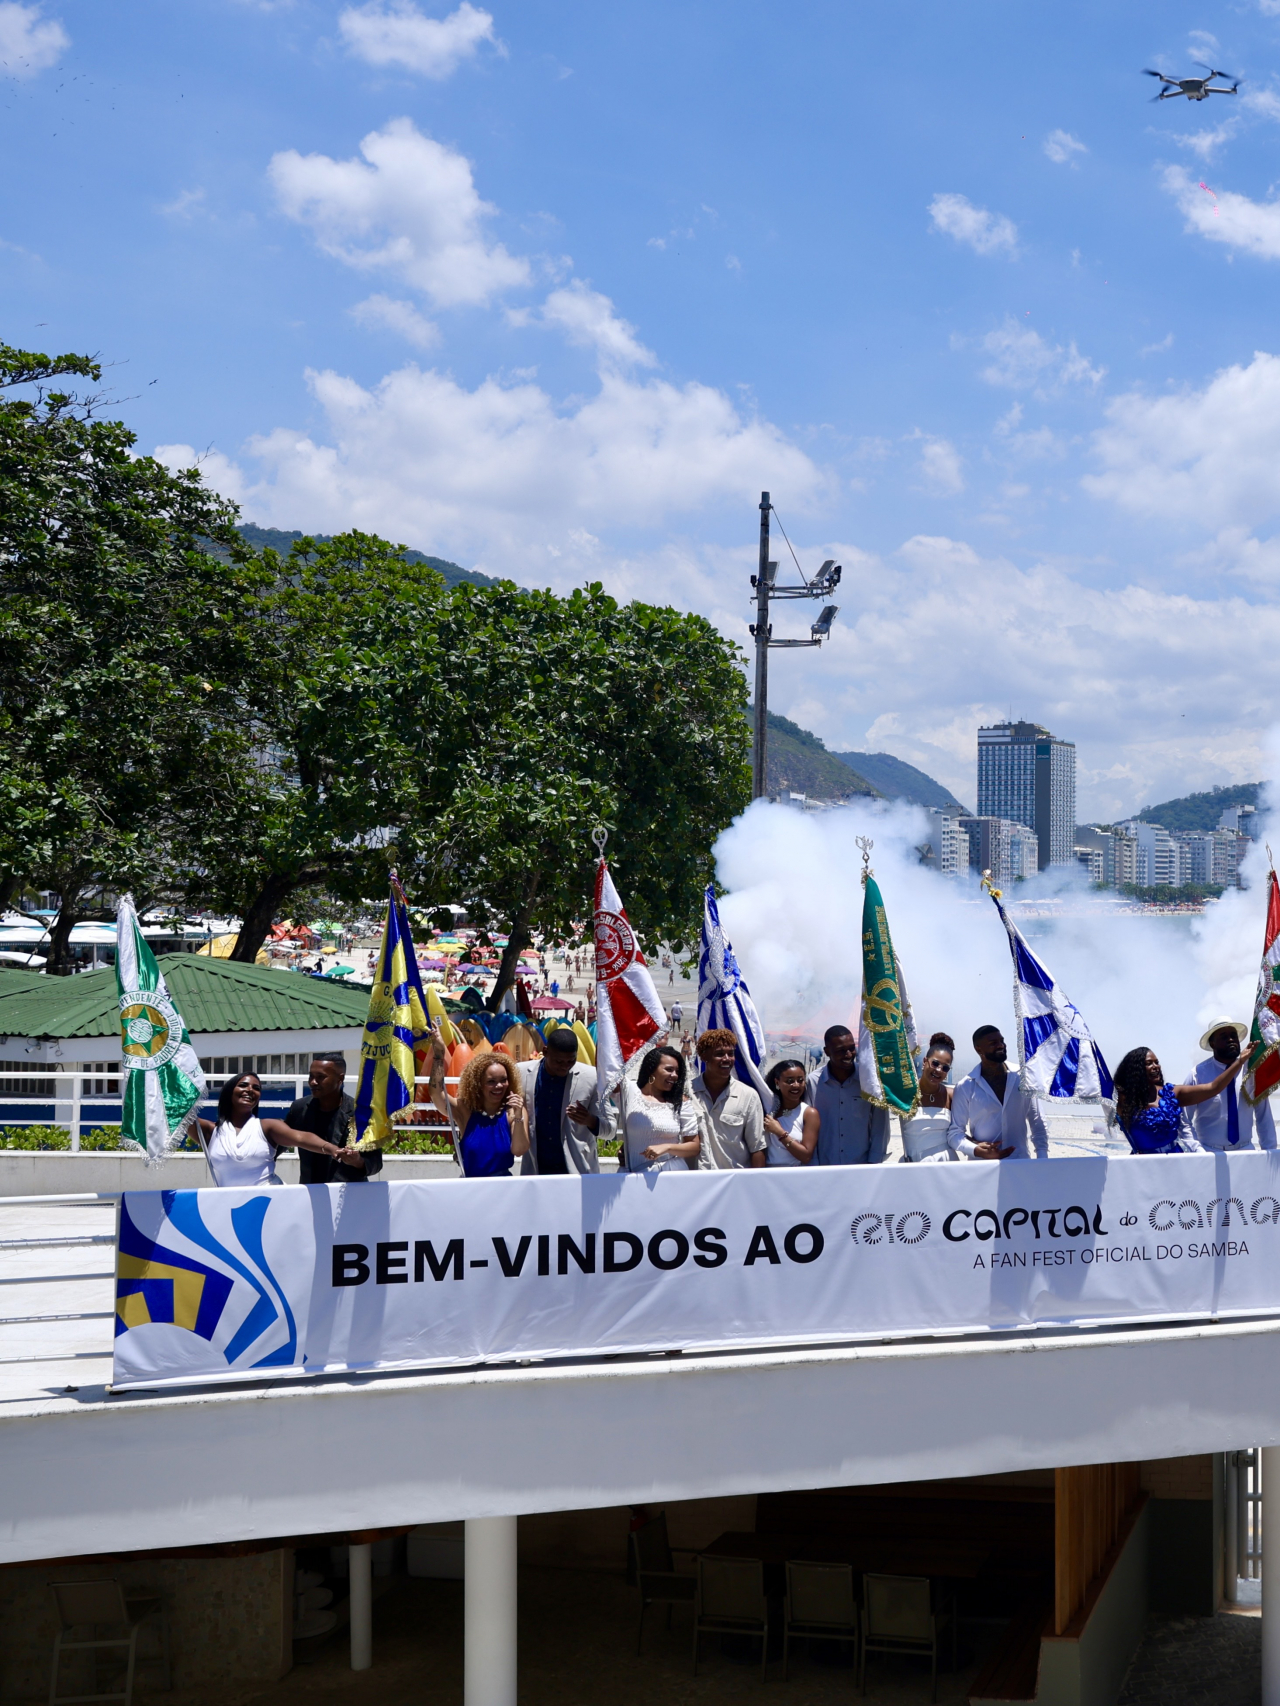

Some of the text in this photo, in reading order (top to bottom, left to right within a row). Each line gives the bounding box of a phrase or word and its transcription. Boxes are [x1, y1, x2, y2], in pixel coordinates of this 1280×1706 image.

[153, 1041, 178, 1065] PADRE
[166, 1013, 181, 1042] MIGUEL
[361, 1041, 391, 1057] TIJUC
[332, 1227, 728, 1287] BEM-VINDOS
[743, 1223, 825, 1266] AO
[851, 1210, 931, 1245] RIO
[1119, 1211, 1138, 1227] do
[973, 1241, 1250, 1269] A FAN FEST OFICIAL DO SAMBA
